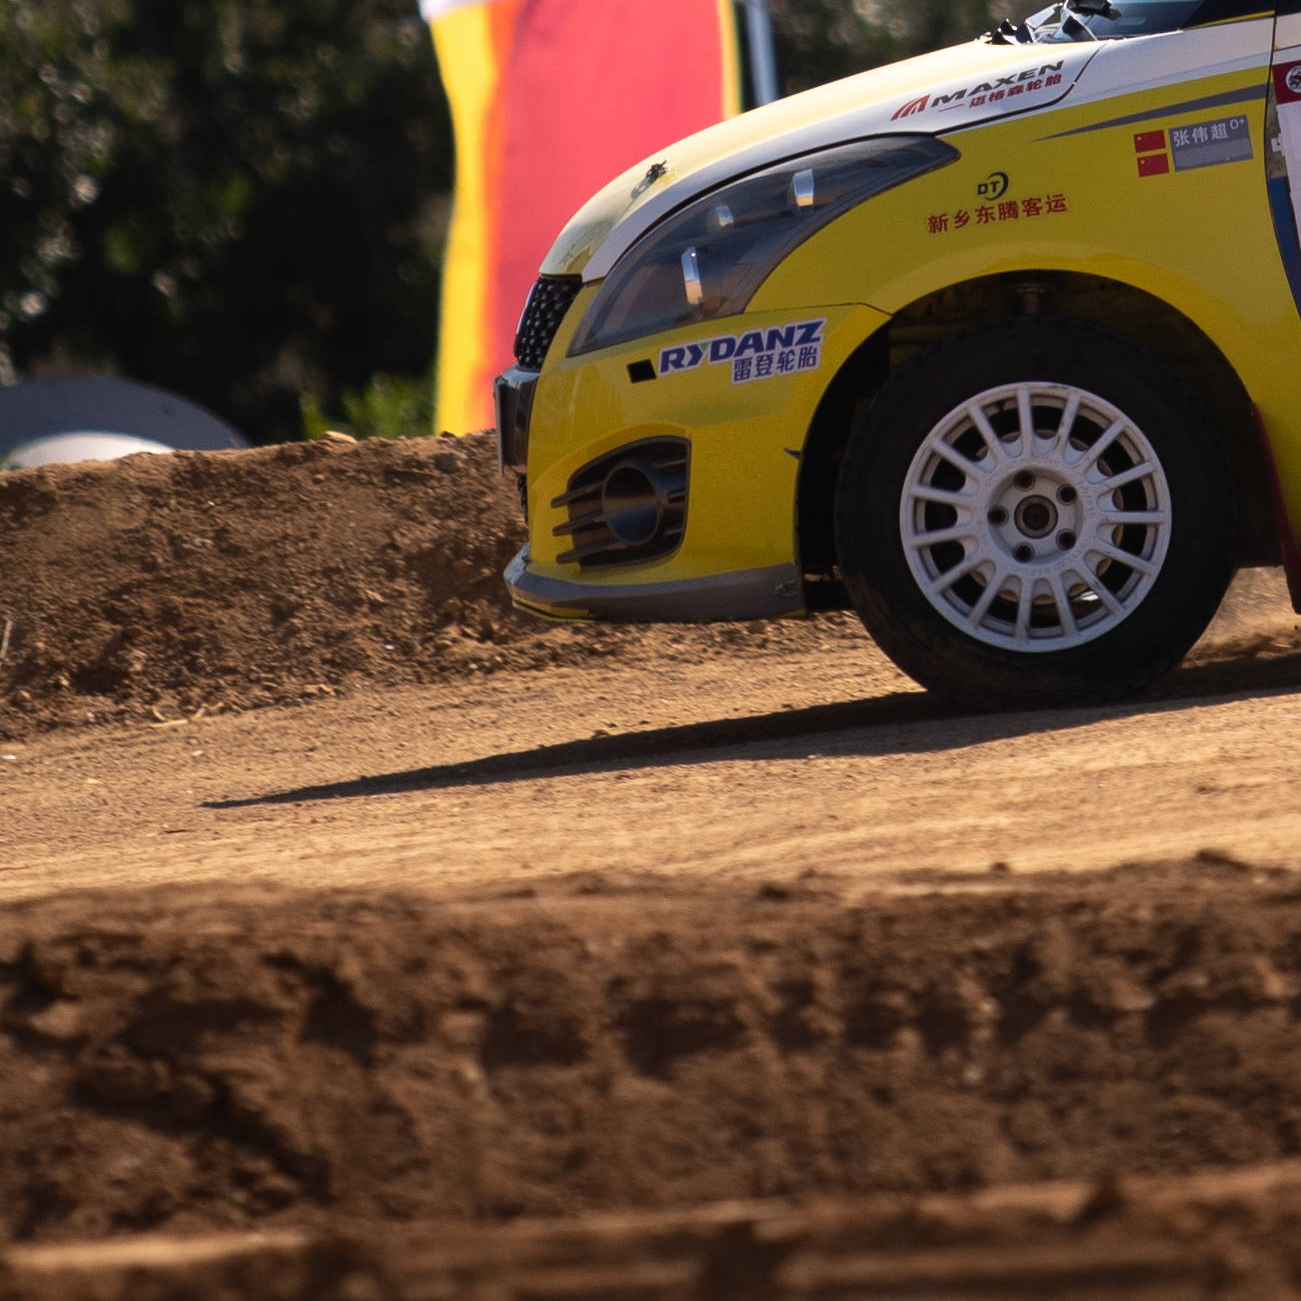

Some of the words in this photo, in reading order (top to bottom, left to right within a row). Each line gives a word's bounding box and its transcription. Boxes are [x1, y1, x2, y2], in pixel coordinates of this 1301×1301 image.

[931, 60, 1064, 108] MAXEN
[1172, 121, 1228, 148] 张伟超
[927, 193, 1068, 235] 新乡东腾客运
[660, 321, 824, 374] RYDANZ
[733, 346, 817, 382] 雷登轮胎
